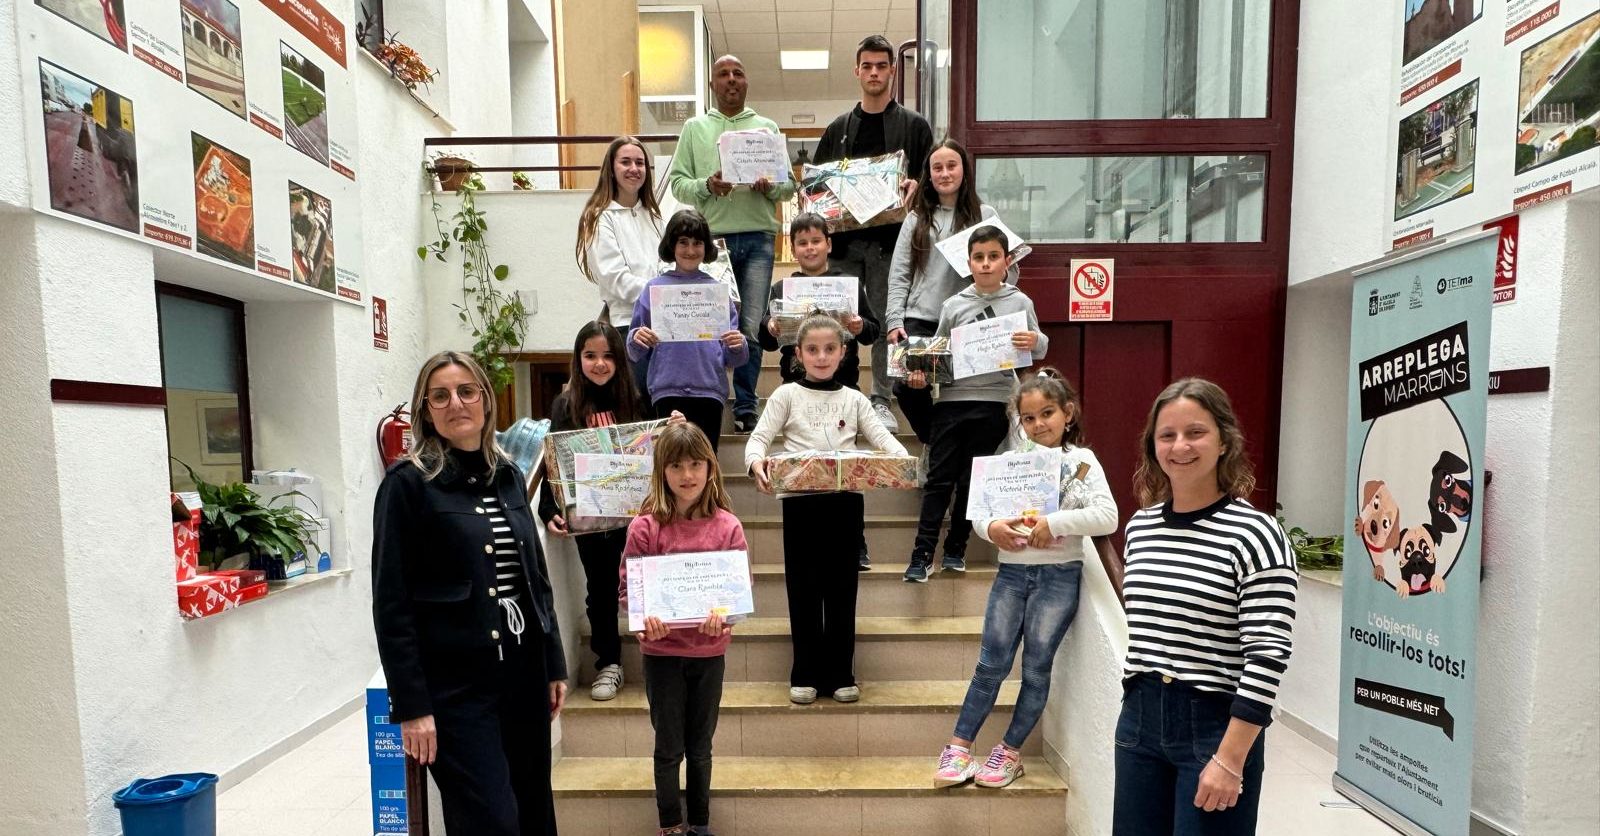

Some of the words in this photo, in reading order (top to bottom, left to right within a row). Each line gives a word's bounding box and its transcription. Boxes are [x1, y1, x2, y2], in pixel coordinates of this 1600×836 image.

[1532, 177, 1551, 188] Campo
[1361, 333, 1466, 391] ARREPLEGA
[1367, 611, 1422, 641] L'objectiu
[1426, 629, 1440, 647] és
[1350, 626, 1423, 664] recollir-los
[1428, 649, 1466, 680] tots!
[1356, 686, 1369, 698] PER
[1370, 689, 1381, 702] UN
[1381, 692, 1405, 708] POBLE
[1406, 696, 1423, 713] MÉS
[1423, 703, 1440, 717] NET
